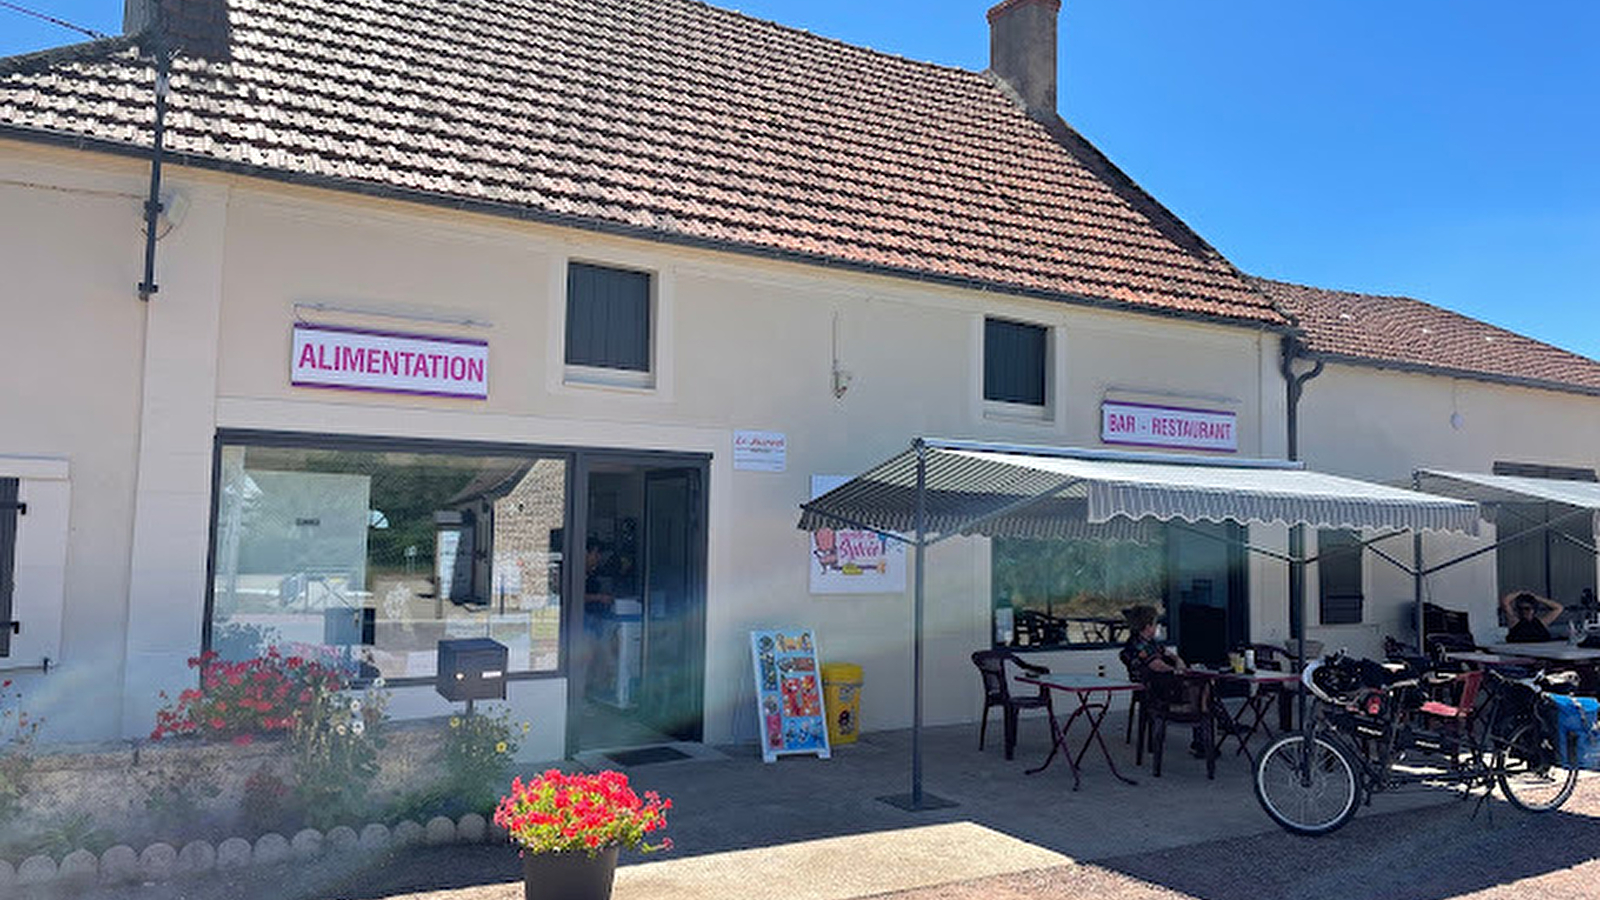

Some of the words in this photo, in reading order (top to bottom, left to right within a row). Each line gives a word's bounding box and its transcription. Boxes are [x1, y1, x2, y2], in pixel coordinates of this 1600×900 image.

[299, 343, 484, 382] ALIMENTATION
[1108, 413, 1136, 433] BAR
[1151, 417, 1232, 440] RESTAURANT
